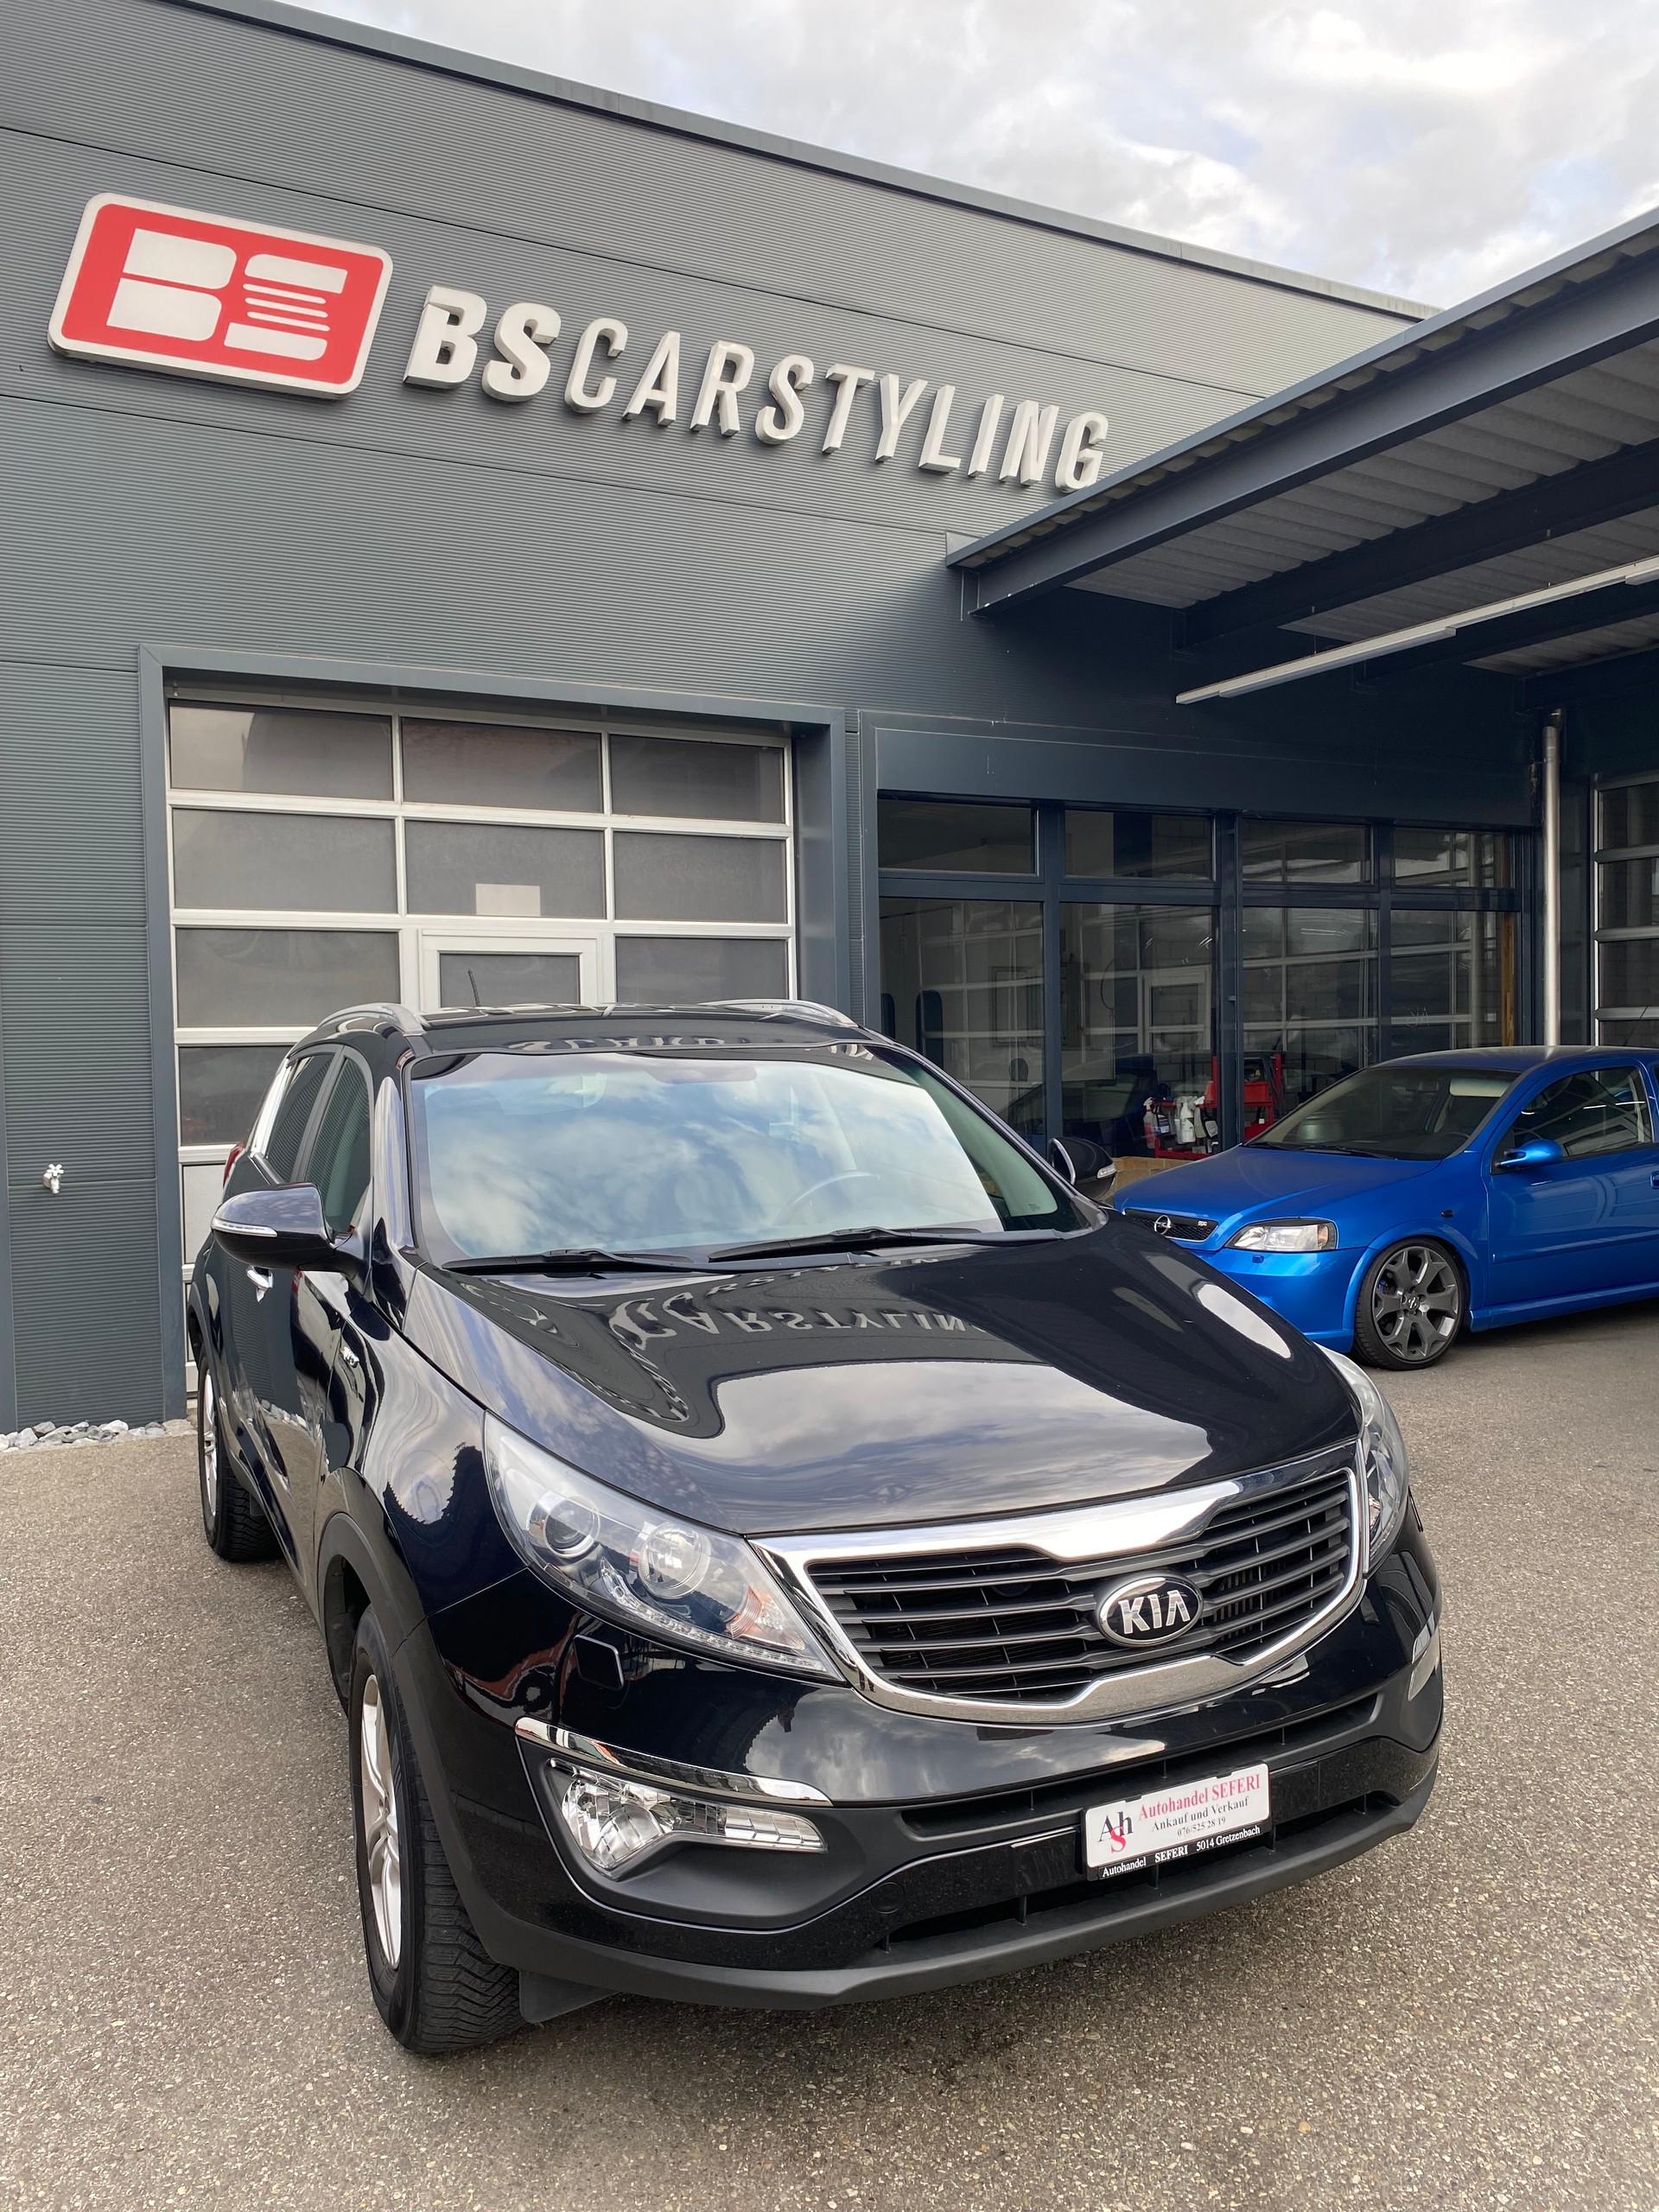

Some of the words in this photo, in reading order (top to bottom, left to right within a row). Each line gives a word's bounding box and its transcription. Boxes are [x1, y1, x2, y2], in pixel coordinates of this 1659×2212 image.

[1118, 1589, 1191, 1635] KIA
[1138, 1787, 1208, 1821] Autohandel
[1211, 1773, 1261, 1802] SEFERI
[1152, 1813, 1189, 1832] Ankauf
[1191, 1808, 1209, 1821] und
[1211, 1796, 1249, 1815] Verkauf
[1207, 1820, 1216, 1829] 28
[1217, 1816, 1226, 1826] 19
[1102, 1856, 1147, 1878] Autohandel
[1154, 1845, 1189, 1864] SEFERI
[1196, 1838, 1215, 1852] 5014
[1215, 1825, 1261, 1846] Gretzenbach
